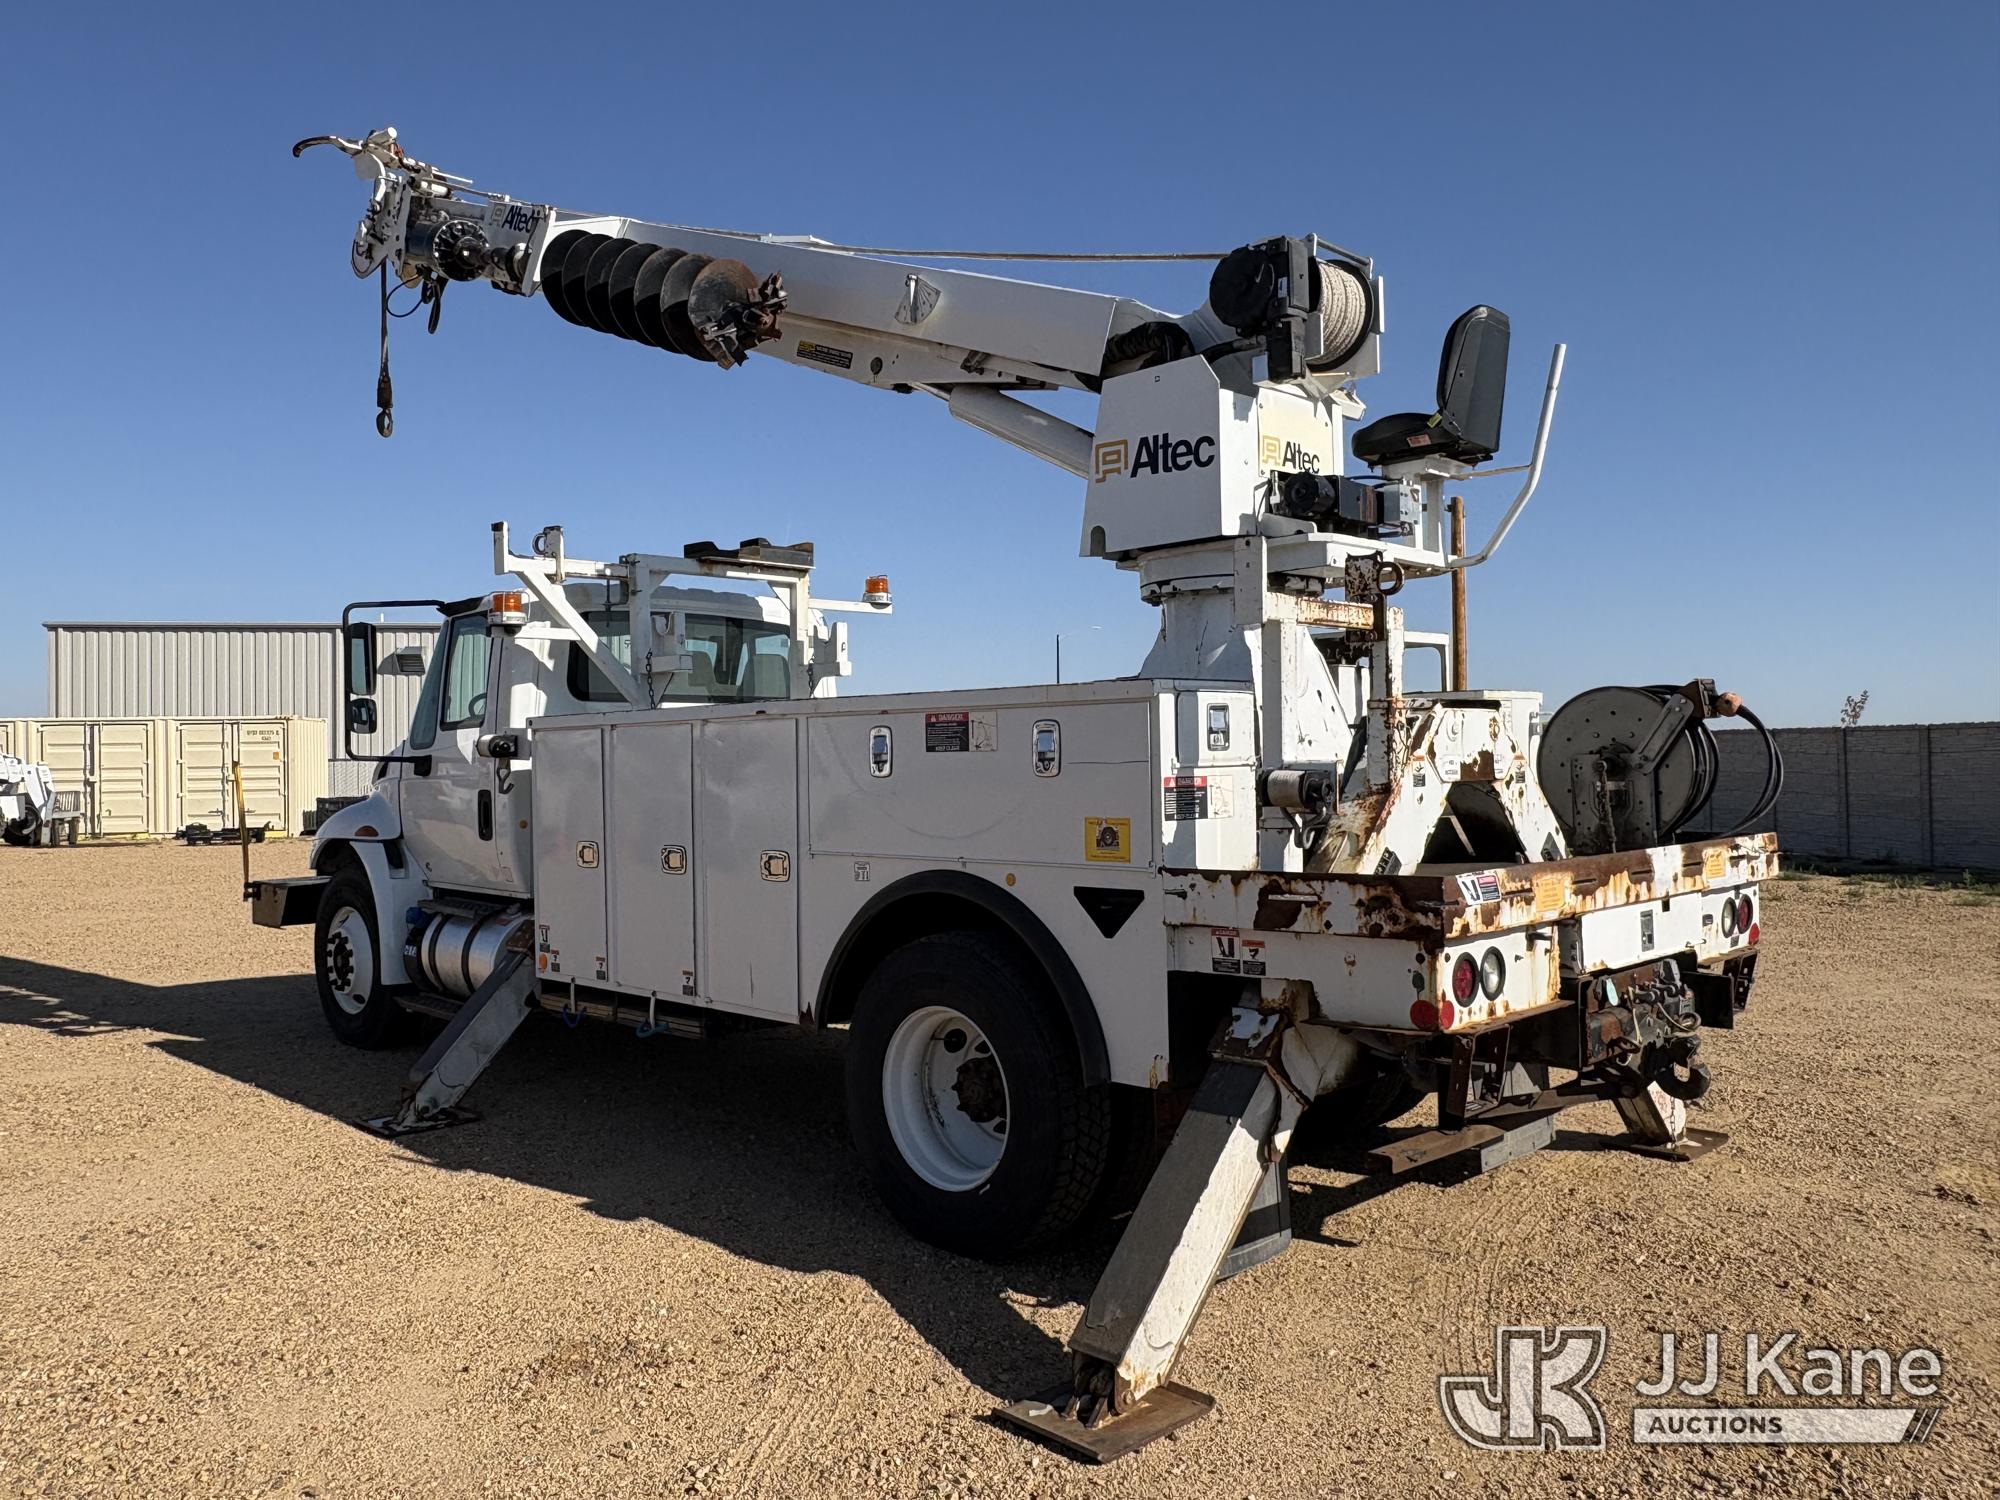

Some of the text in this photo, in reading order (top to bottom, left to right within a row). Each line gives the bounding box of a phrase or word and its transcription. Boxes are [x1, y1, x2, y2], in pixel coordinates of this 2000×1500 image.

[501, 205, 536, 233] Altec
[1130, 432, 1215, 478] Altec
[1282, 441, 1320, 474] Altec
